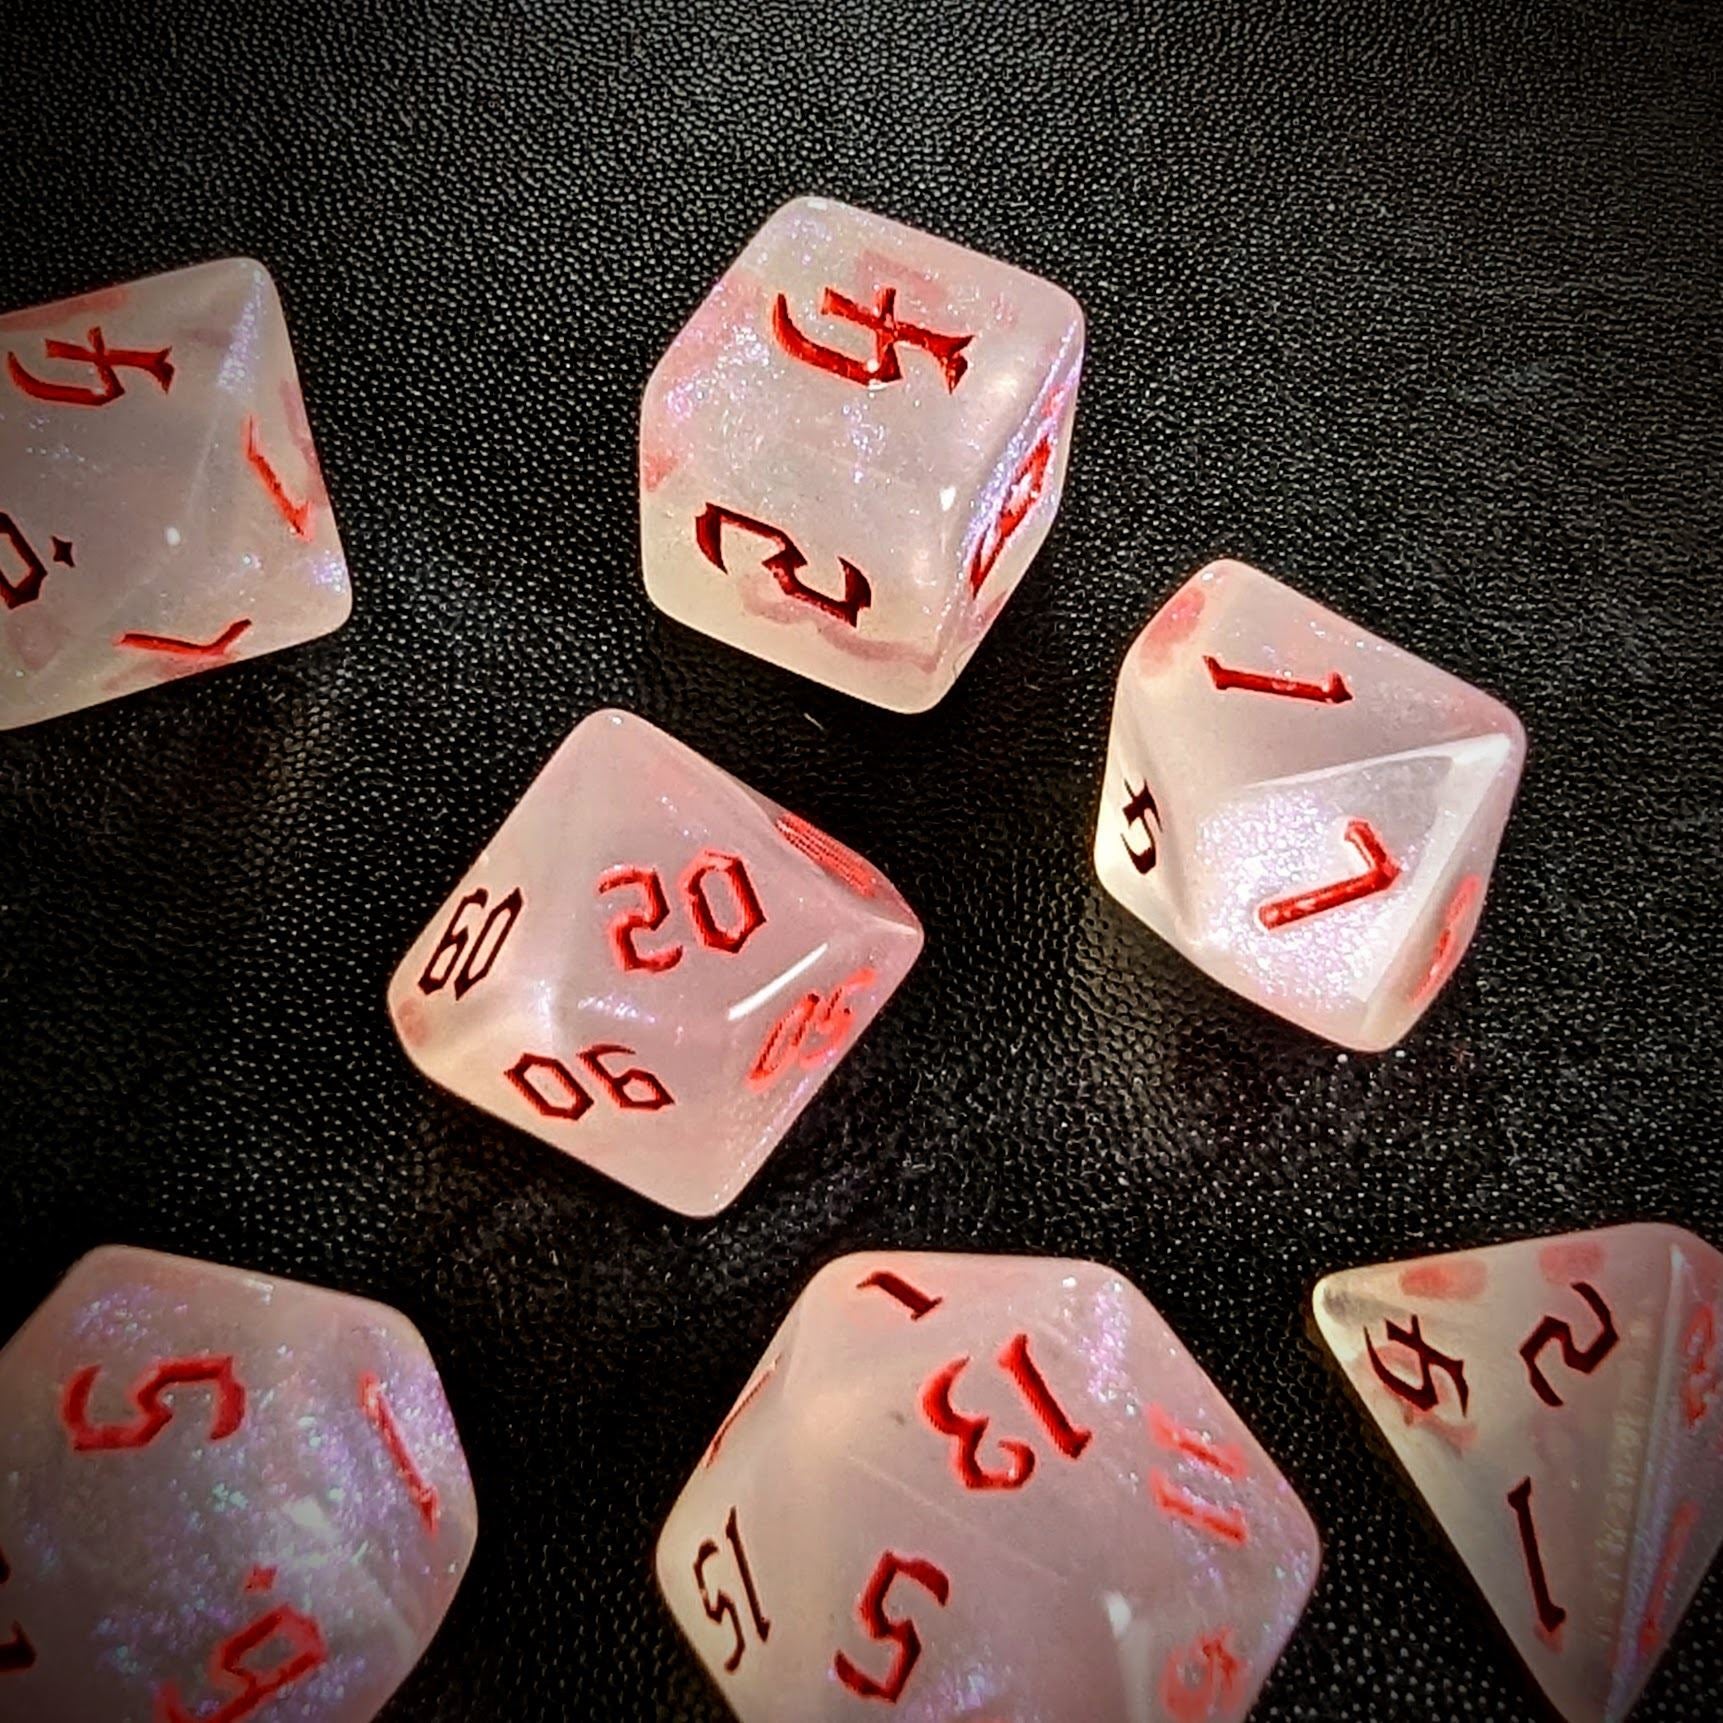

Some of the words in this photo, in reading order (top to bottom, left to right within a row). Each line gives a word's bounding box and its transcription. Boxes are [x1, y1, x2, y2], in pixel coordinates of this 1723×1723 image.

[7, 325, 175, 406] 4
[772, 288, 972, 395] 4
[1204, 655, 1354, 705] 1
[598, 848, 767, 973] 20
[1256, 816, 1402, 931] 7
[857, 1271, 942, 1320] 1
[1519, 1281, 1620, 1408] 2
[62, 1354, 247, 1452] 5
[920, 1333, 1093, 1489] 13
[1364, 1314, 1469, 1419] 4
[1507, 1475, 1568, 1633] 1
[834, 1550, 950, 1702] 5
